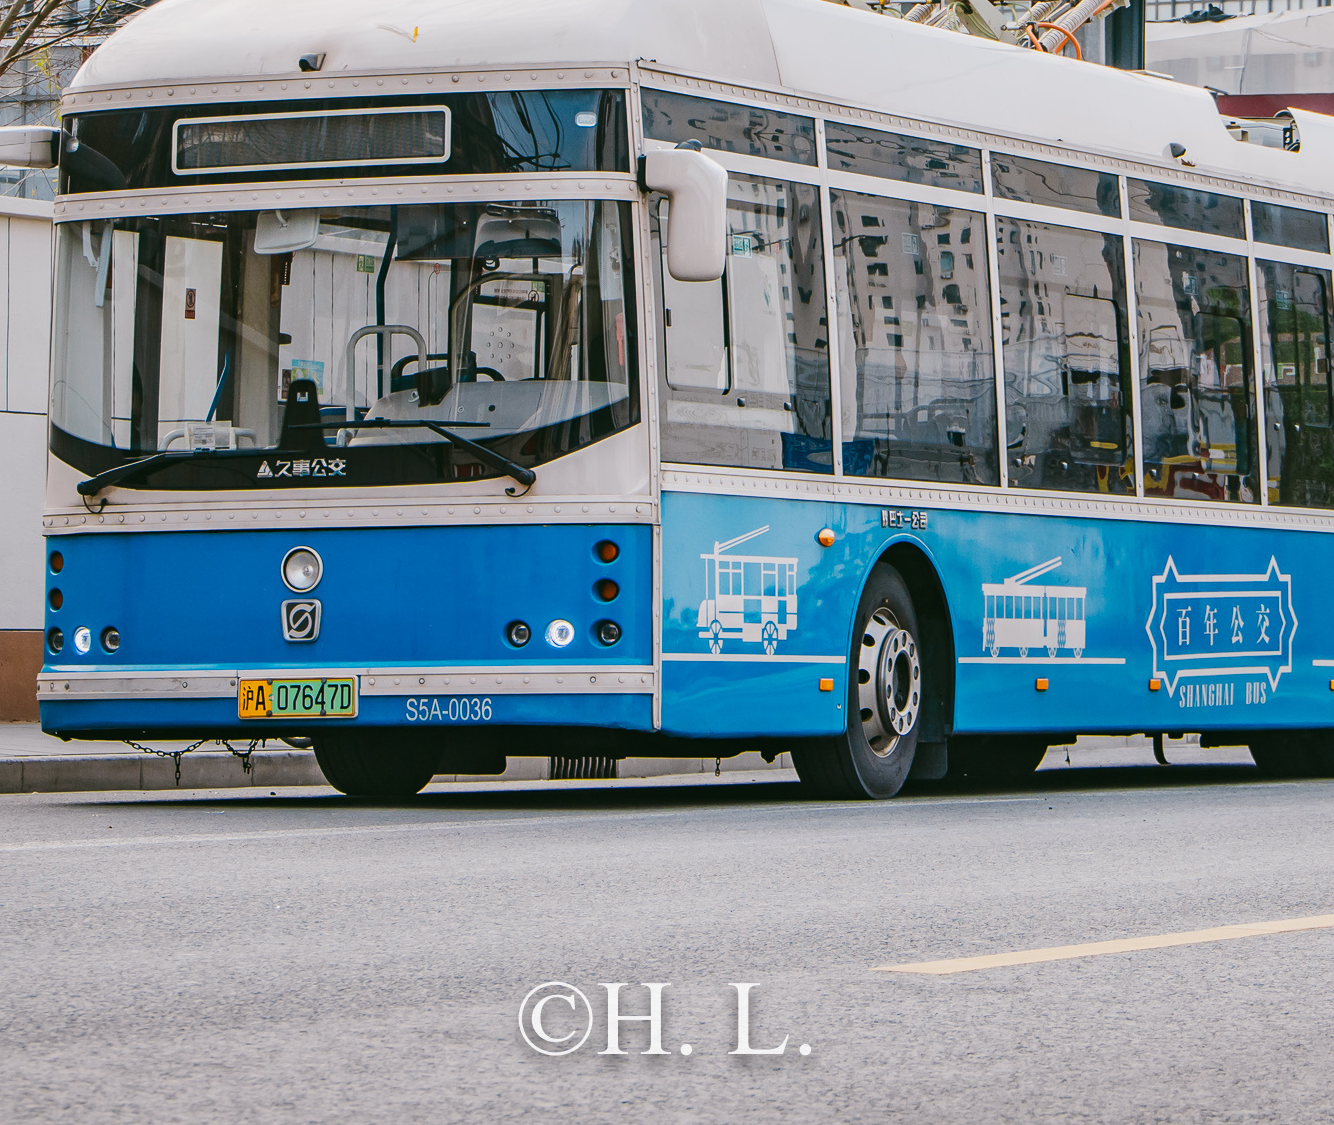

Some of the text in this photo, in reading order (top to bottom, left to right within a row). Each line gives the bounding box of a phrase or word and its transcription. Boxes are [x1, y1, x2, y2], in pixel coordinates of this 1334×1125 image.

[274, 458, 347, 477] 久事公交
[1176, 603, 1271, 646] 百年公交
[1178, 681, 1267, 708] SHANGHAI BUS
[405, 697, 493, 722] S5A-0036
